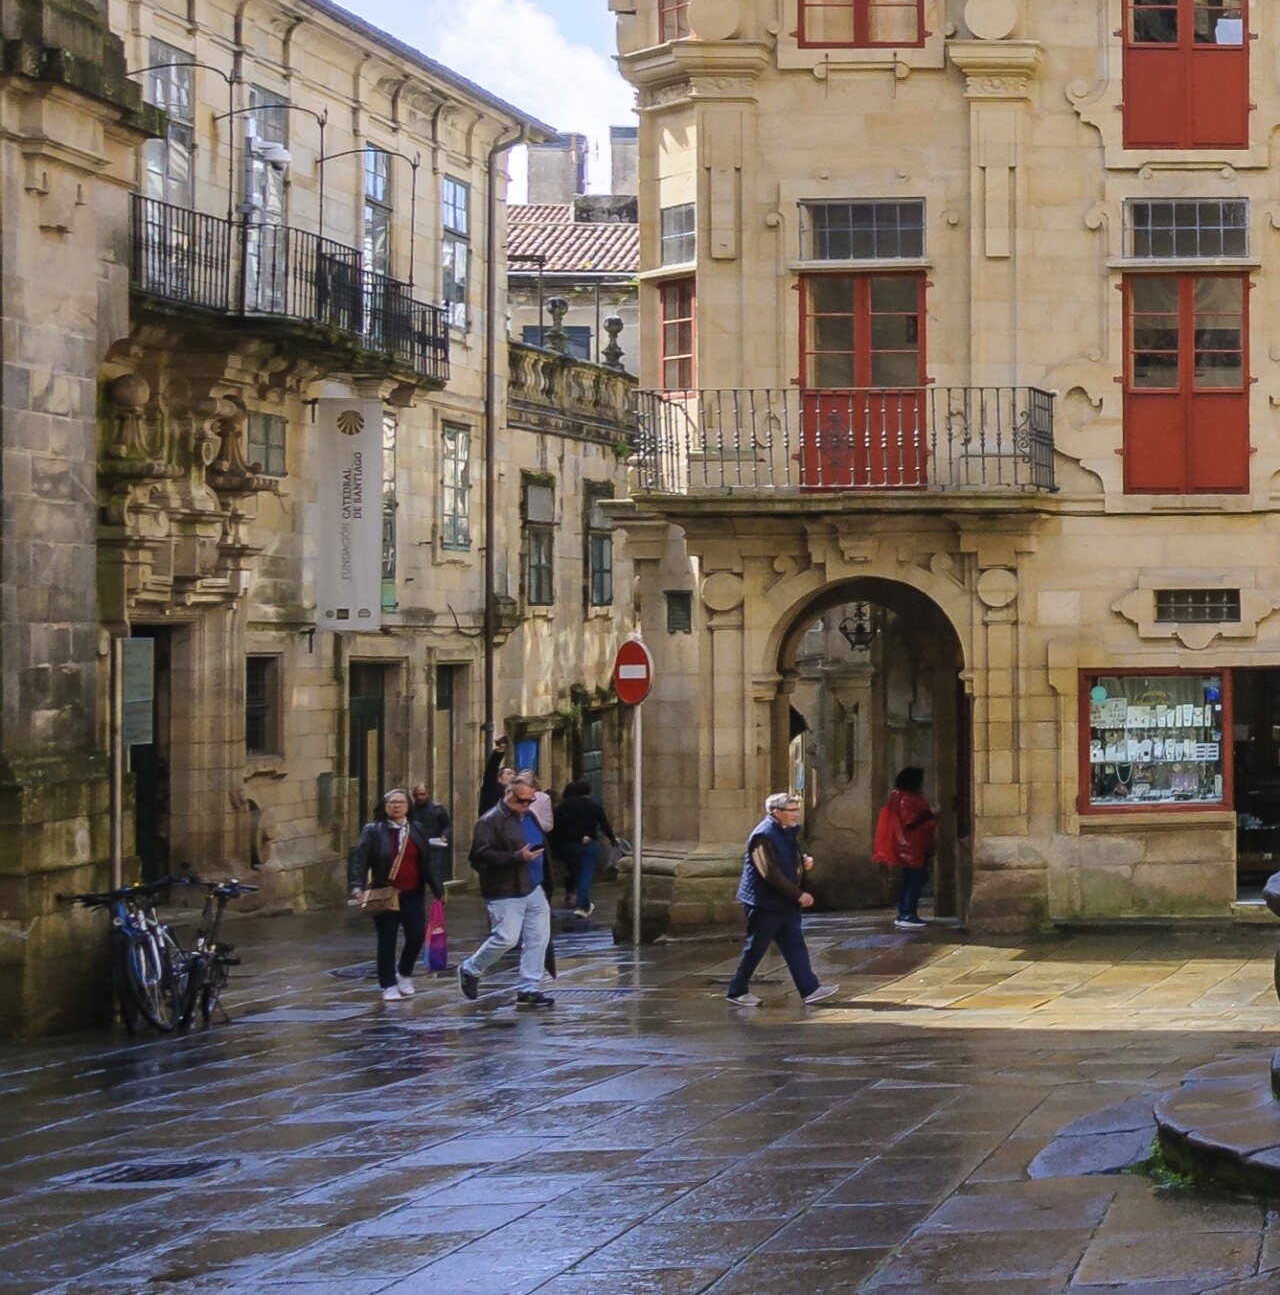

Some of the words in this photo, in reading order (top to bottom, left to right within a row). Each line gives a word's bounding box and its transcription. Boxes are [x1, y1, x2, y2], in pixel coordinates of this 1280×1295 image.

[342, 468, 351, 519] CATEDRAL
[354, 452, 362, 504] SANTIAGO
[353, 506, 362, 519] DE
[341, 522, 351, 581] FUNDACIÓN
